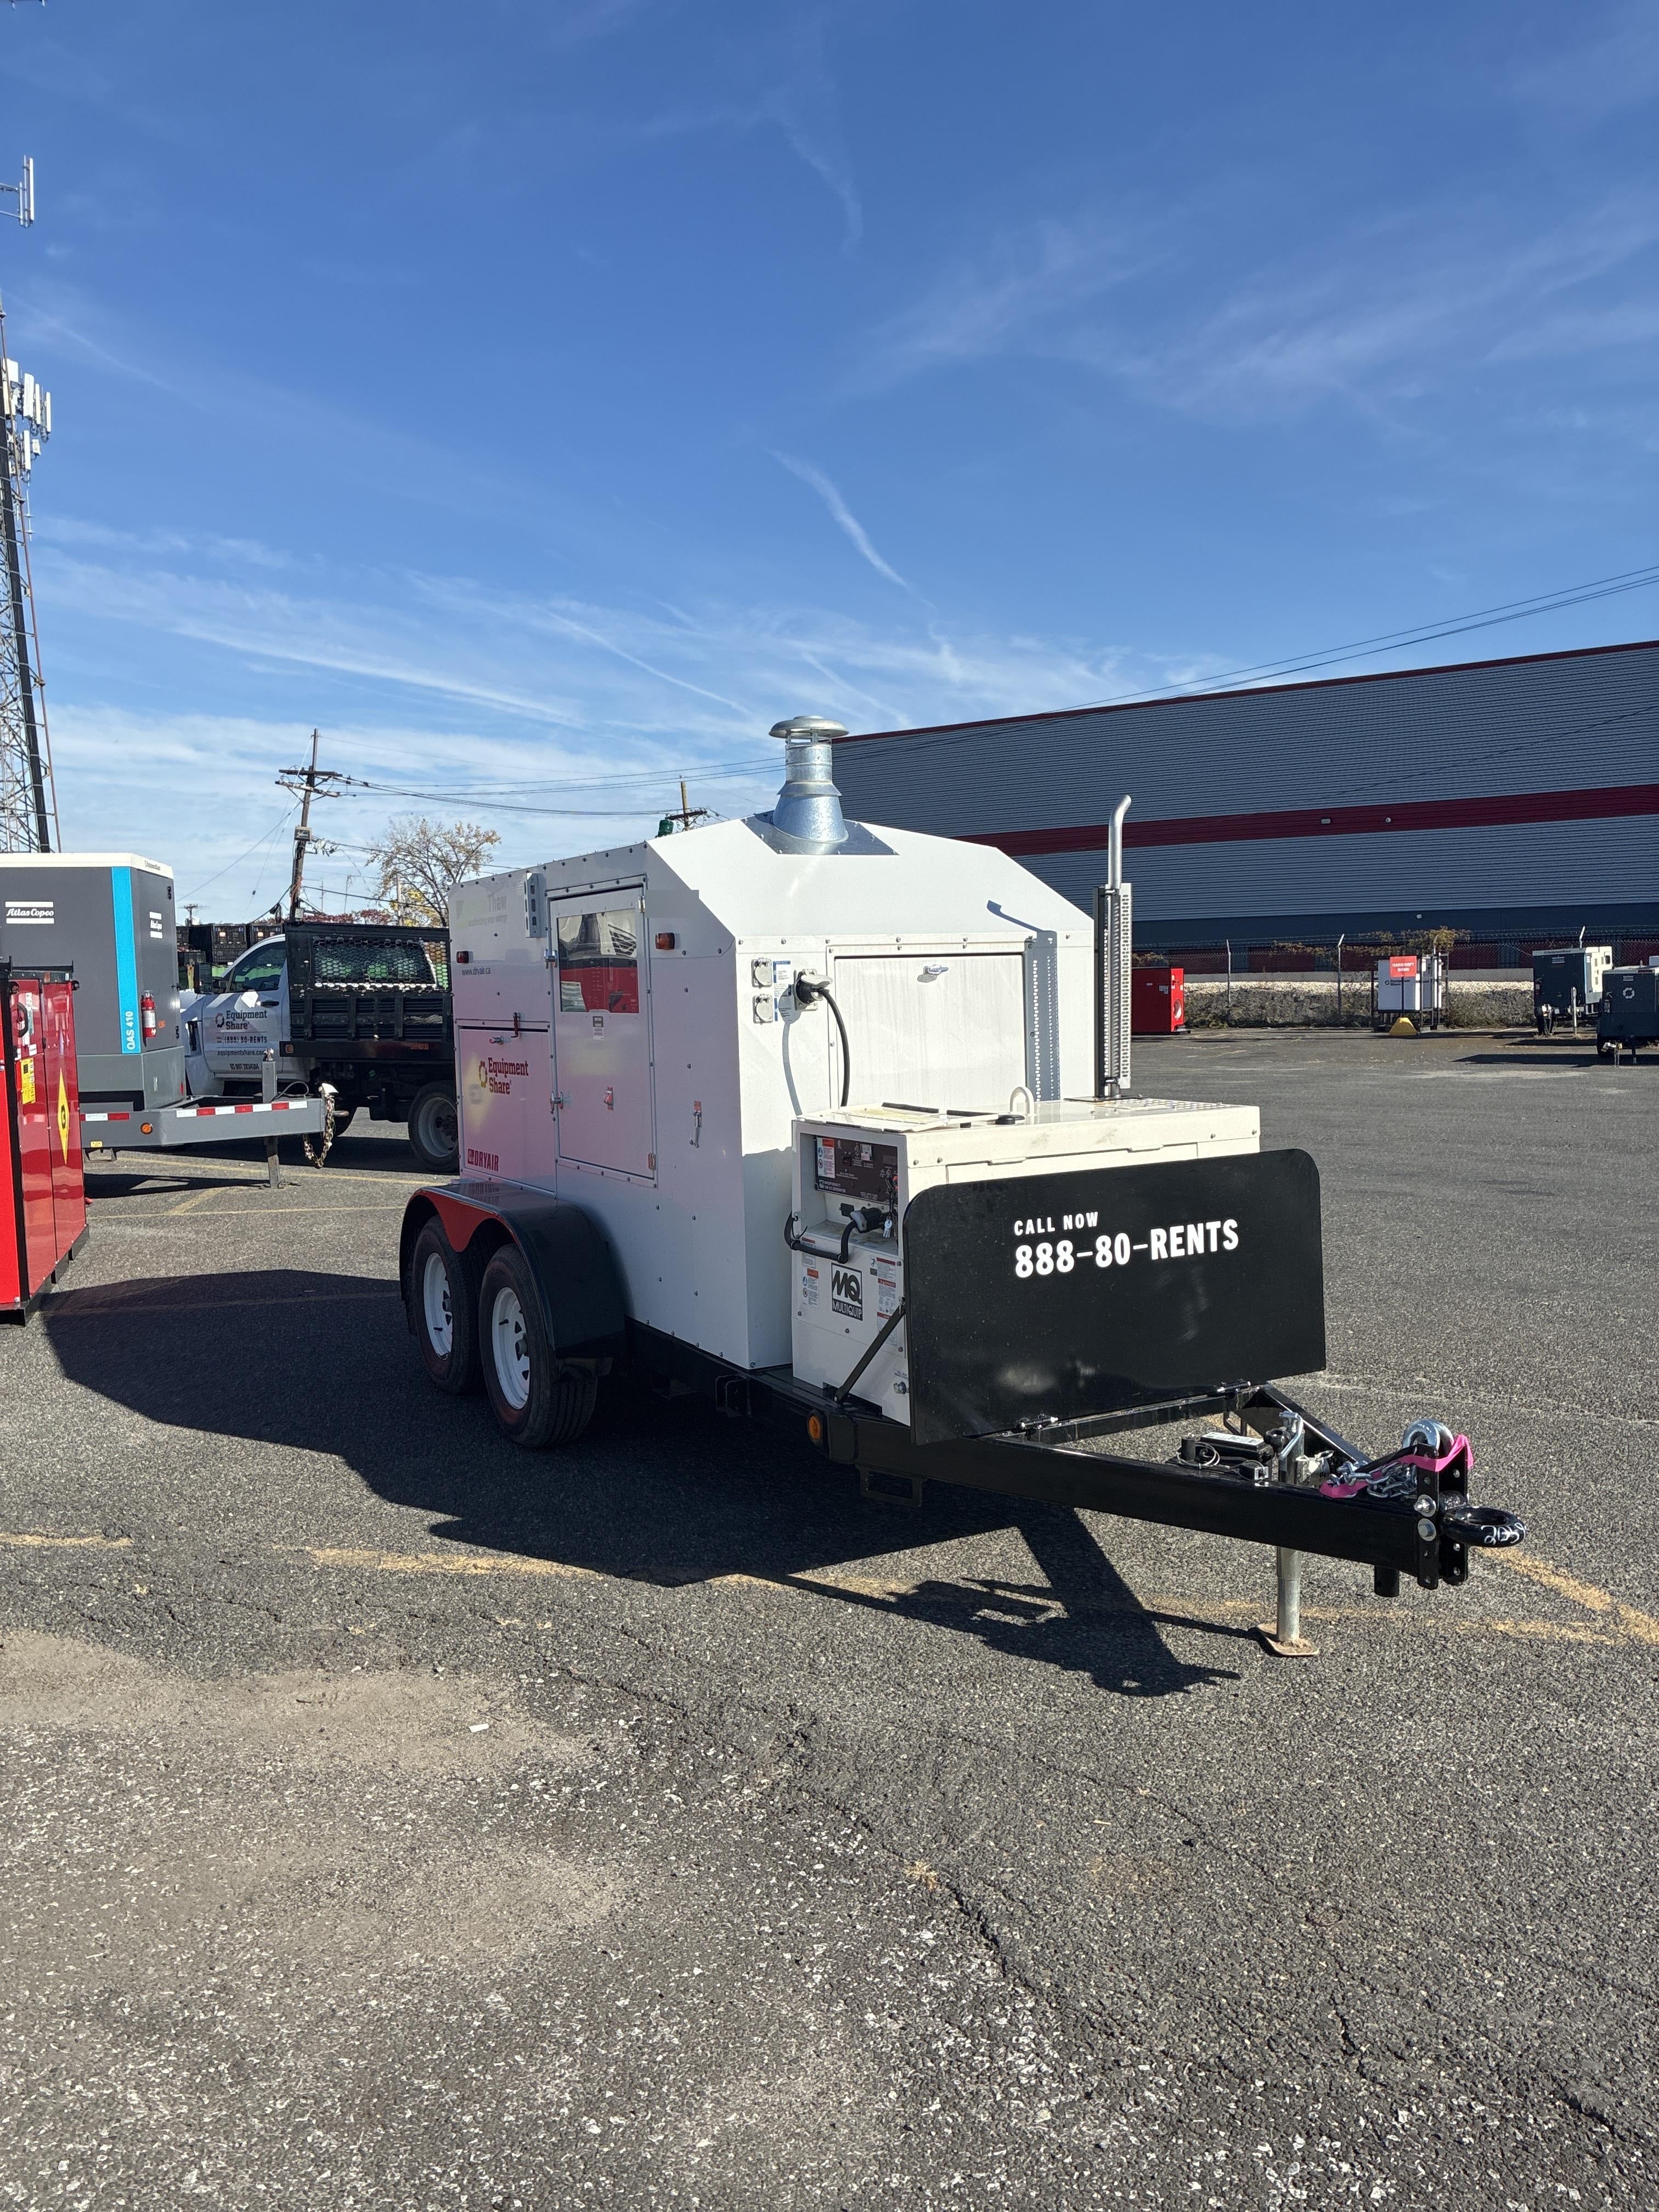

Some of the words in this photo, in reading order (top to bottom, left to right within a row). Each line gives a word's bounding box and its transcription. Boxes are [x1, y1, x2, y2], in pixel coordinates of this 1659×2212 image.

[6, 908, 30, 916] Atlas
[31, 908, 54, 918] Copco
[461, 967, 491, 977] www.dryair.ca
[125, 1011, 134, 1028] 410
[226, 1010, 268, 1020] Equipment
[488, 1057, 529, 1077] Equipment
[474, 1150, 499, 1172] DRYAIR
[1014, 1217, 1056, 1235] CALL
[1063, 1211, 1098, 1230] NOW
[1015, 1219, 1239, 1278] 888-80-RENTS
[832, 1270, 862, 1304] MQ
[833, 1300, 862, 1319] MULTIQUIP
